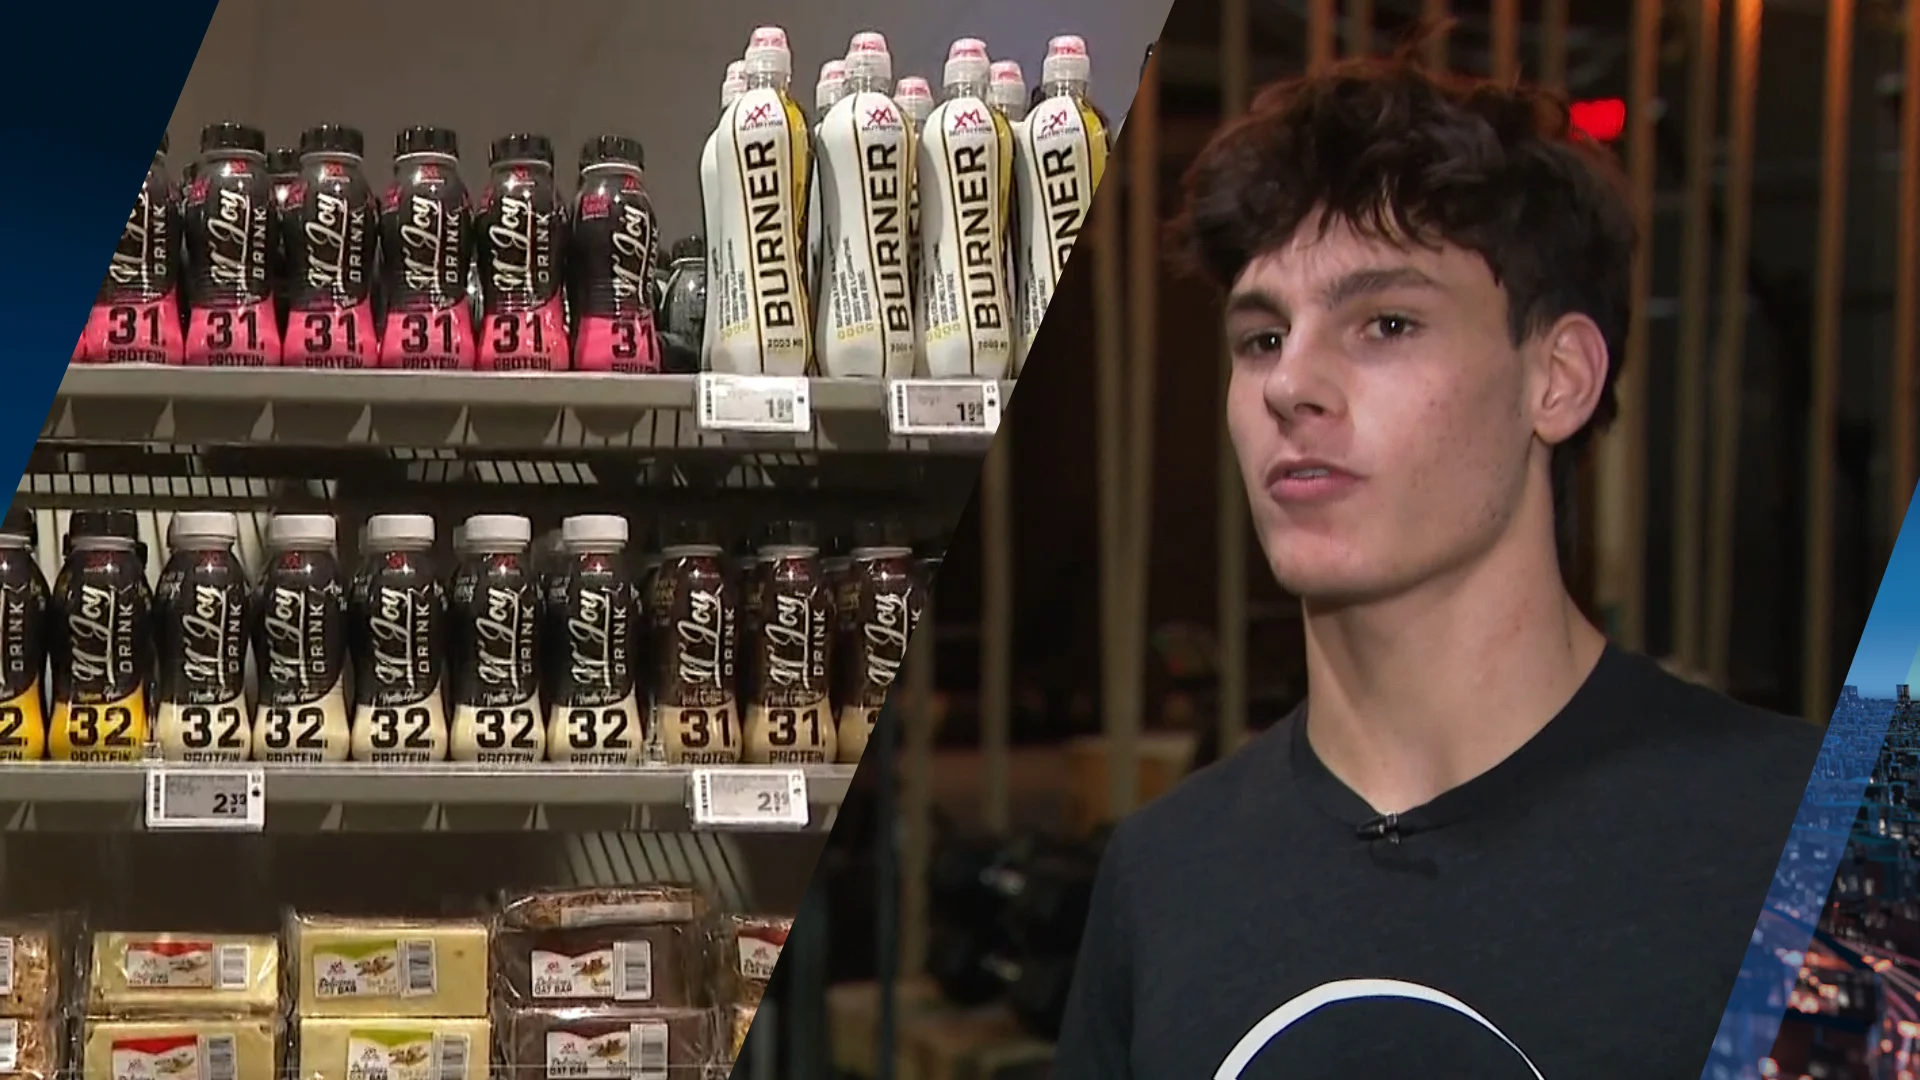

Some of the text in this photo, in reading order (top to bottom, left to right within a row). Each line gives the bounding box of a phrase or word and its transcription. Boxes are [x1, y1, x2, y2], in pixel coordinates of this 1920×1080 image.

[153, 204, 168, 275] DRINK
[252, 207, 267, 280] DRINK
[350, 211, 365, 284] DRINK
[445, 212, 462, 284] DRINK
[536, 213, 549, 283] DRINK
[744, 139, 794, 327] BURNER
[867, 143, 910, 331] BURNER
[955, 145, 1001, 329] BURNER
[108, 350, 165, 364] PROTEIN
[9, 602, 24, 671] DRINK
[119, 603, 133, 673] DRINK
[228, 604, 242, 672] DRINK
[309, 603, 325, 674] DRINK
[416, 603, 430, 673] DRINK
[520, 605, 534, 674] DRINK
[614, 605, 627, 675] DRINK
[724, 607, 735, 675] DRINK
[813, 609, 825, 675] DRINK
